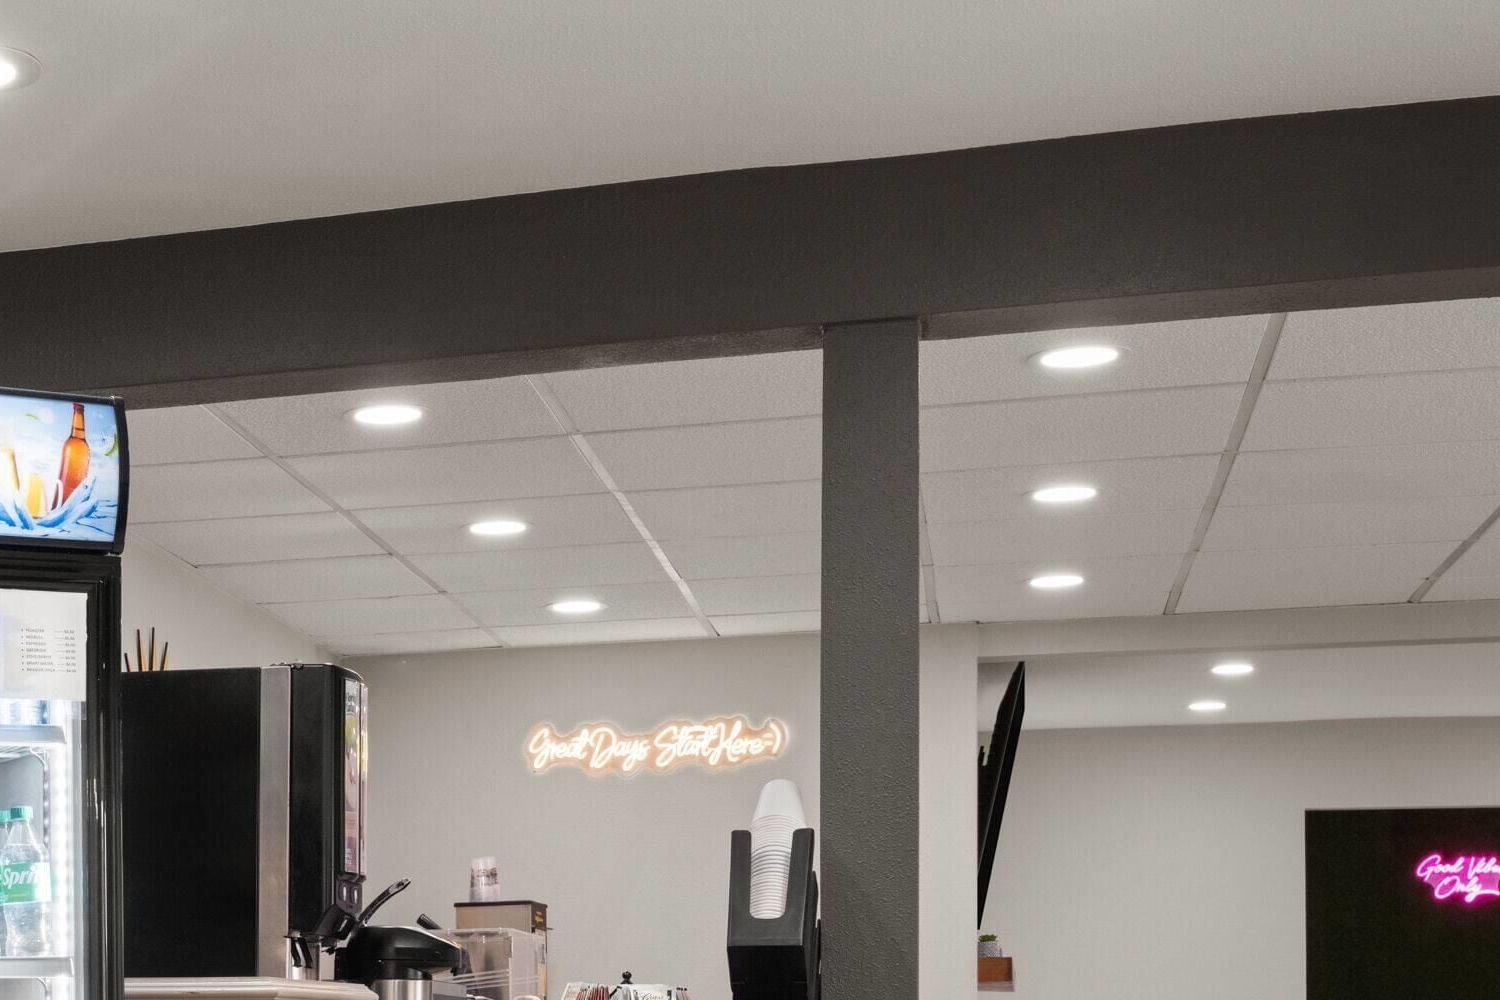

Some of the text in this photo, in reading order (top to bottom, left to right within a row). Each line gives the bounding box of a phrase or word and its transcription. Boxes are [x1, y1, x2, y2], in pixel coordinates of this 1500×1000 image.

[529, 727, 588, 769] Great
[588, 726, 650, 771] Days
[653, 725, 718, 767] Start
[1416, 854, 1500, 881] Good Vibe
[1434, 875, 1499, 903] Only
